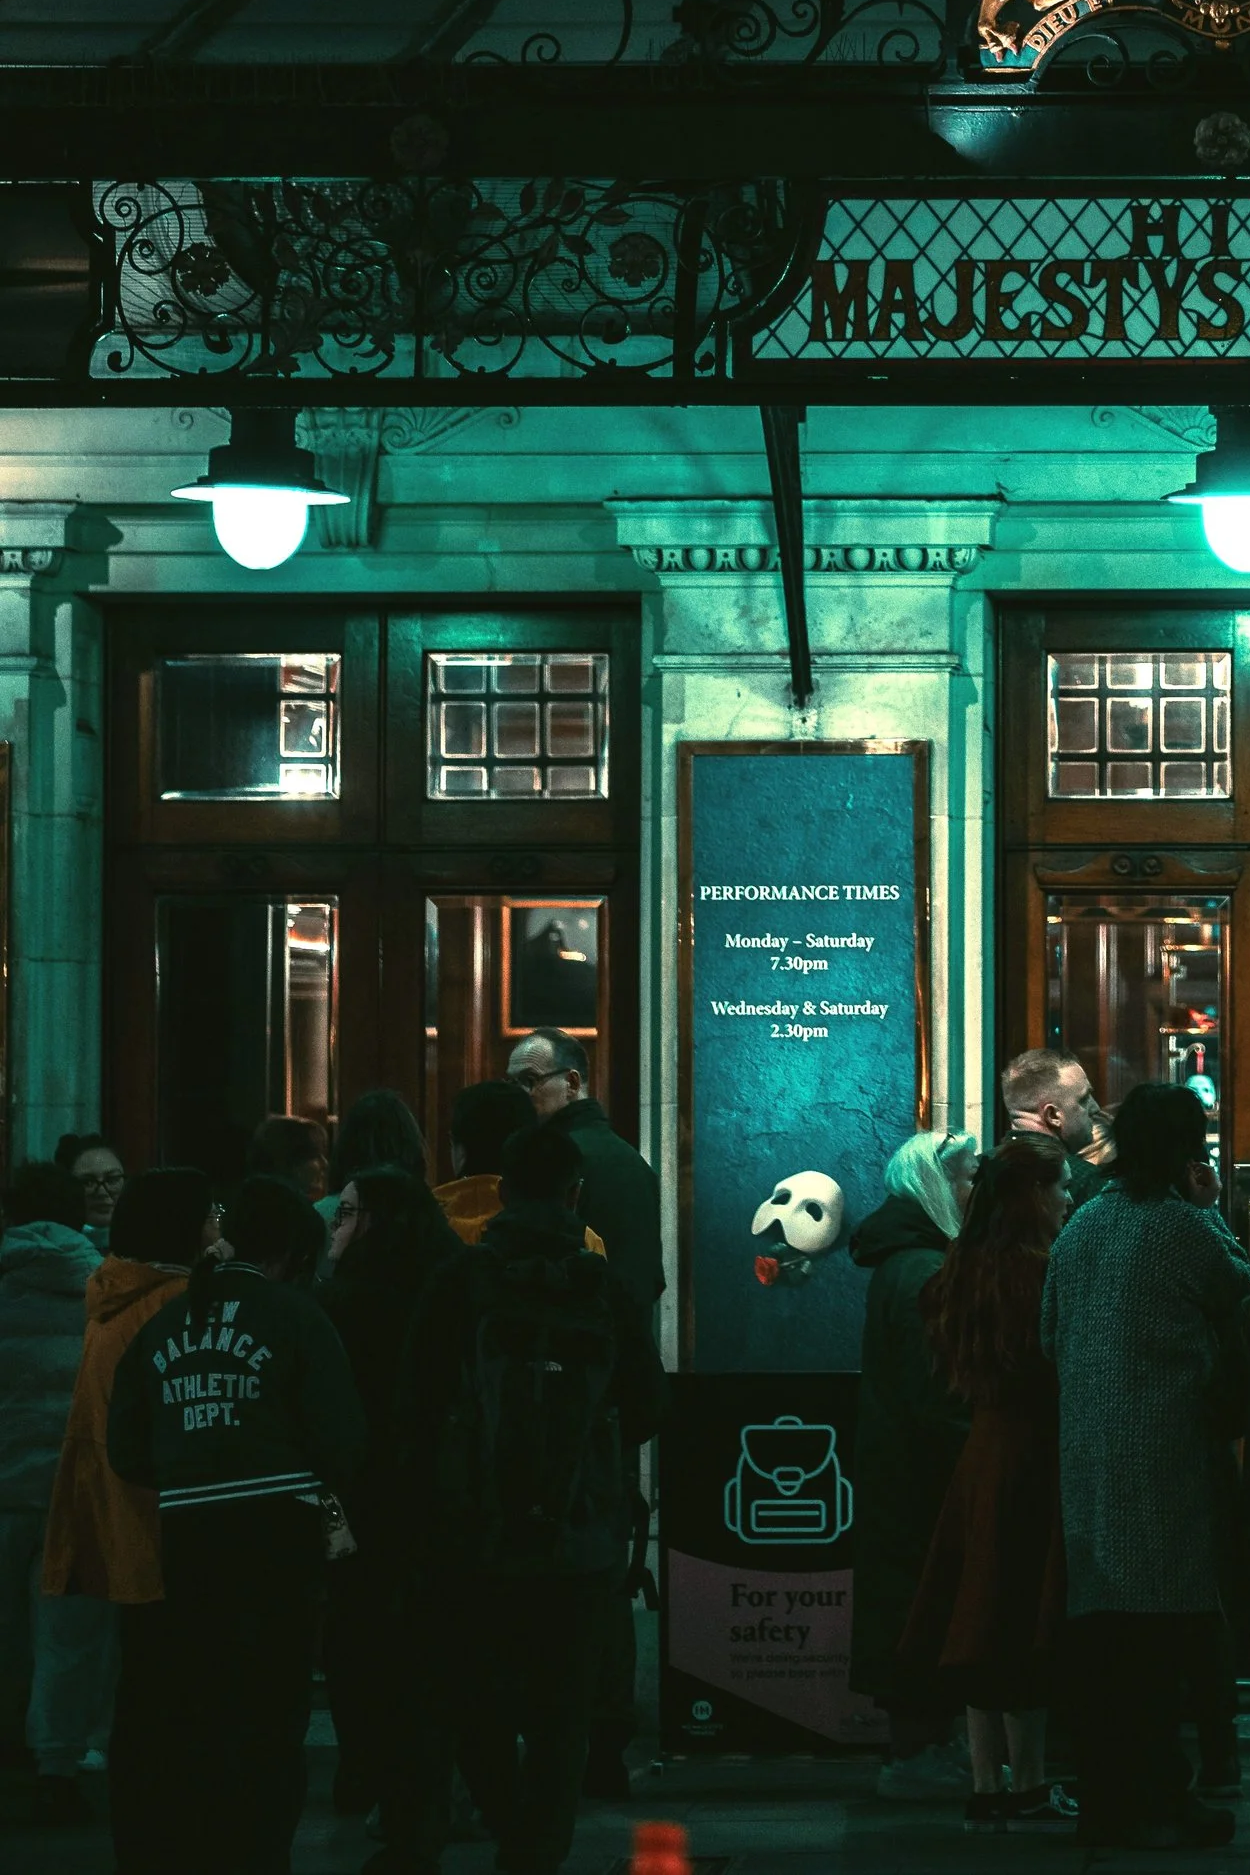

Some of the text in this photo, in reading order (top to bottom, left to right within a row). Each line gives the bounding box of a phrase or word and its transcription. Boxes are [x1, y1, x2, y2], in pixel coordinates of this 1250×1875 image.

[1028, 5, 1079, 53] DIEU
[808, 258, 1247, 342] MAJESTYS
[700, 885, 900, 900] PERFORMANCE TIMES
[725, 933, 789, 952] Monday
[805, 933, 874, 952] Saturday
[770, 956, 828, 974] 7.30pm
[711, 1000, 888, 1019] Wednesday & Saturday
[770, 1024, 828, 1042] 2.30pm
[152, 1326, 273, 1373] BALANCE
[162, 1372, 260, 1404] ATHLETIC
[184, 1402, 240, 1431] DEPT.
[731, 1583, 847, 1615] For your
[730, 1617, 810, 1649] safety
